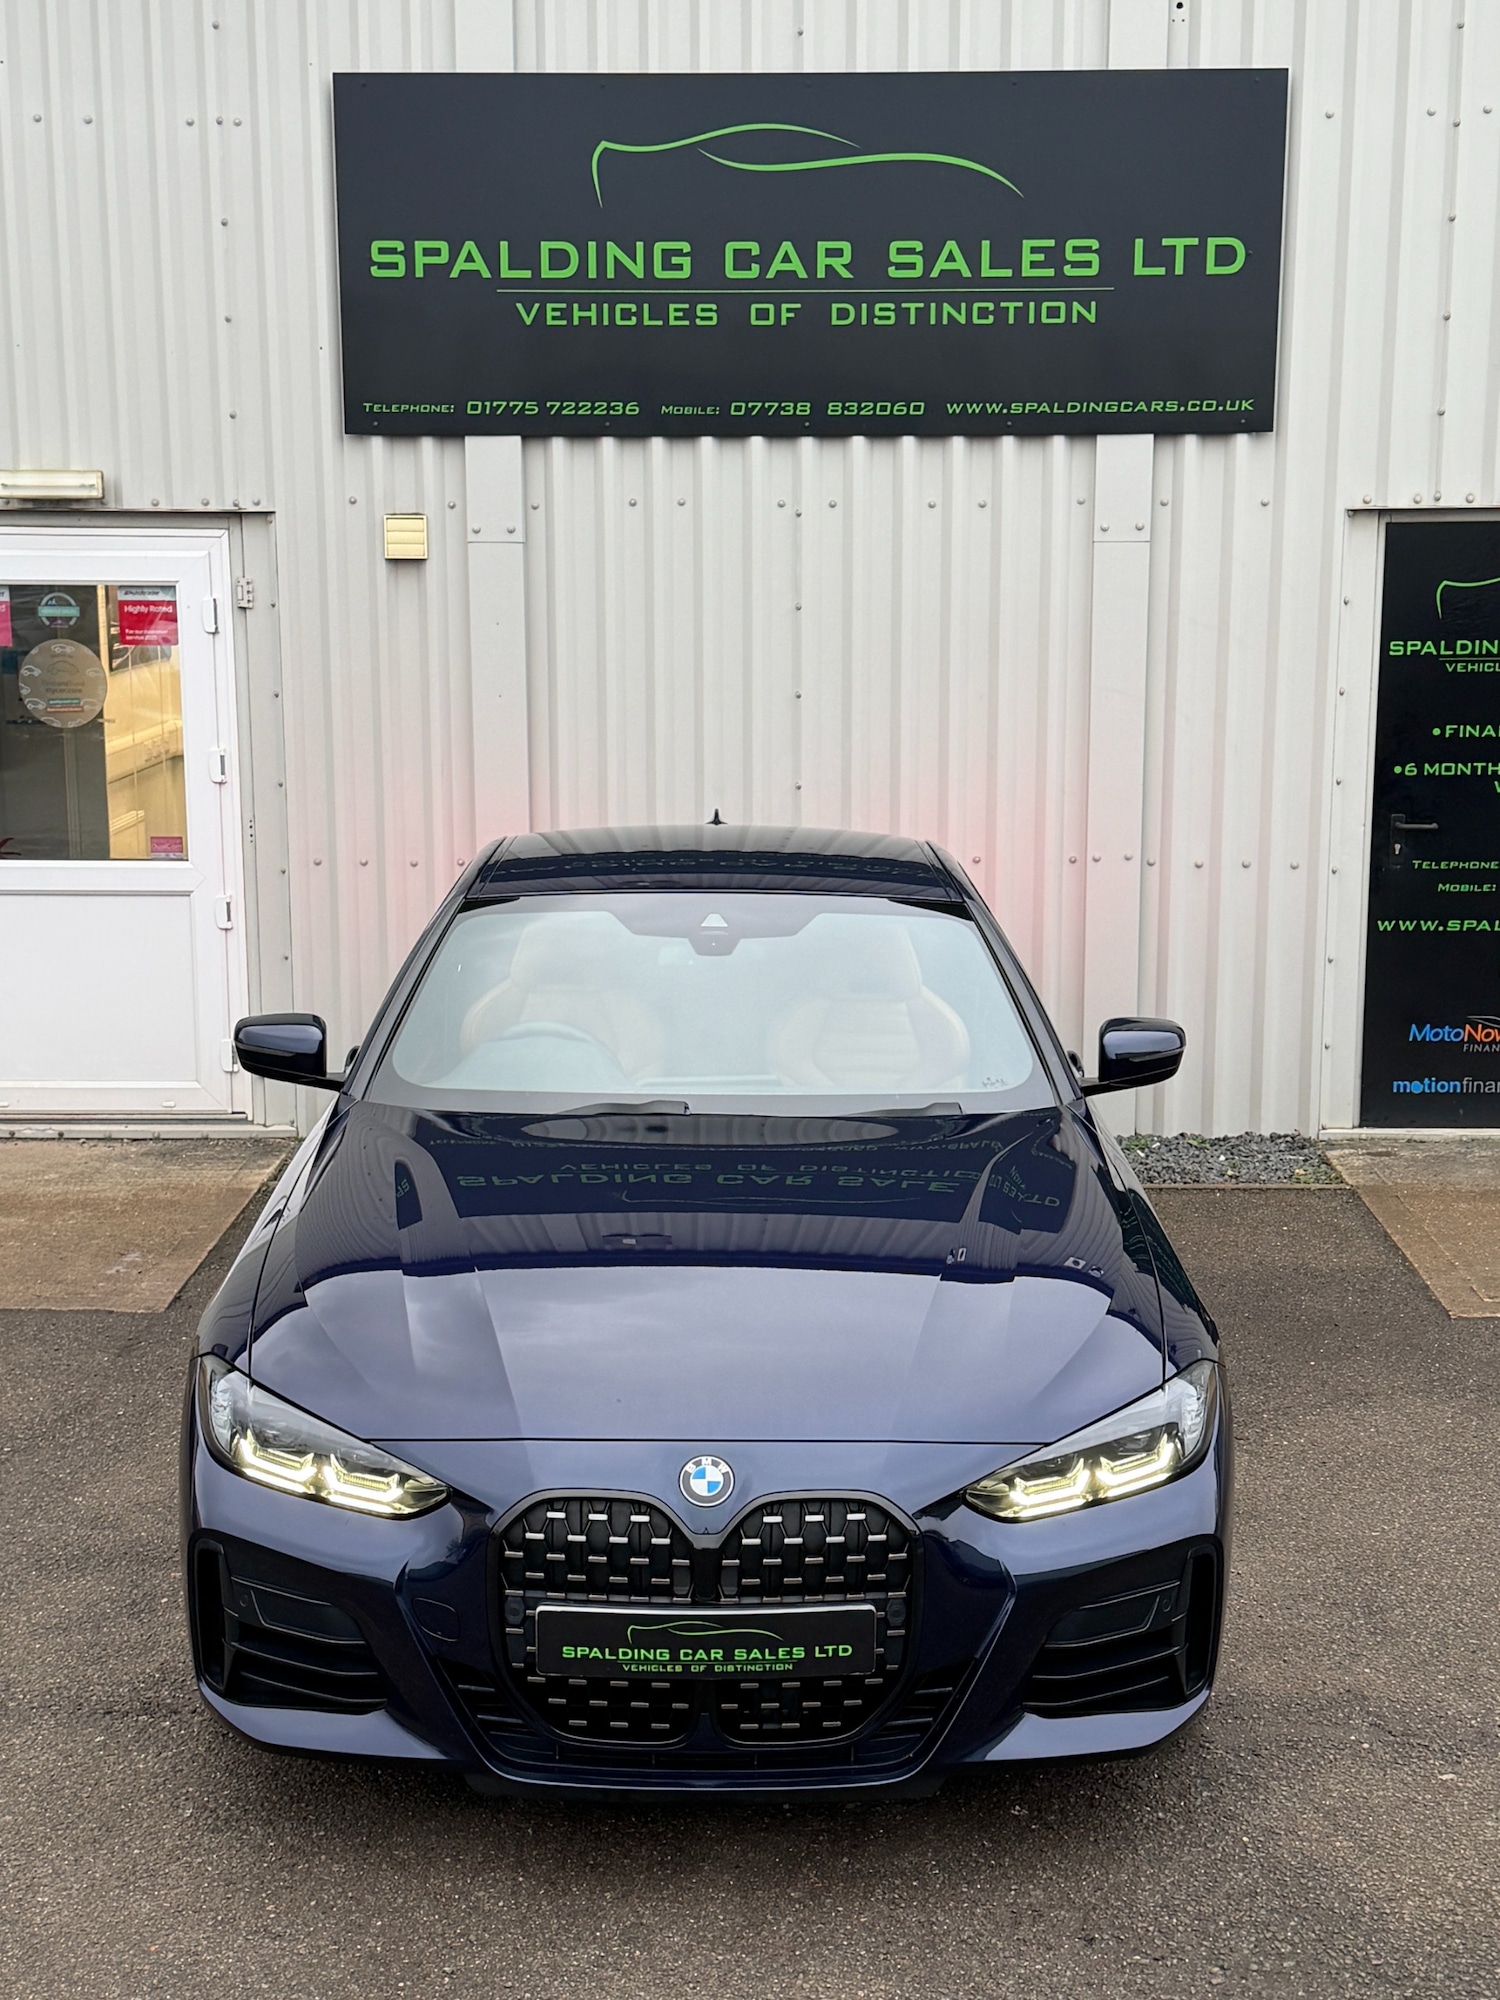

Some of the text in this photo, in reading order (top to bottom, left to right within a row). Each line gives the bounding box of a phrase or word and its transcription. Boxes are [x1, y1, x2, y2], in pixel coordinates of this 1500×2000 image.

[369, 236, 1247, 280] SPALDING CAR SALES LTD
[516, 301, 1097, 327] VEHICLES OF DISTINCTION
[363, 399, 1255, 416] TELEPHONE: 01775 722236 MOBILE: 07738 832060 WWW.SPALDINGCARS.CO.UK
[124, 605, 173, 614] Highly Rated
[1388, 639, 1500, 657] SPALDIN
[1445, 724, 1500, 738] FINA
[1404, 762, 1500, 777] 6 MONTH
[1437, 883, 1497, 892] MOBILE:
[561, 1644, 854, 1662] SPALDING CAR SALES LTD
[621, 1662, 793, 1673] VEHICLES OF DISTINCTION
